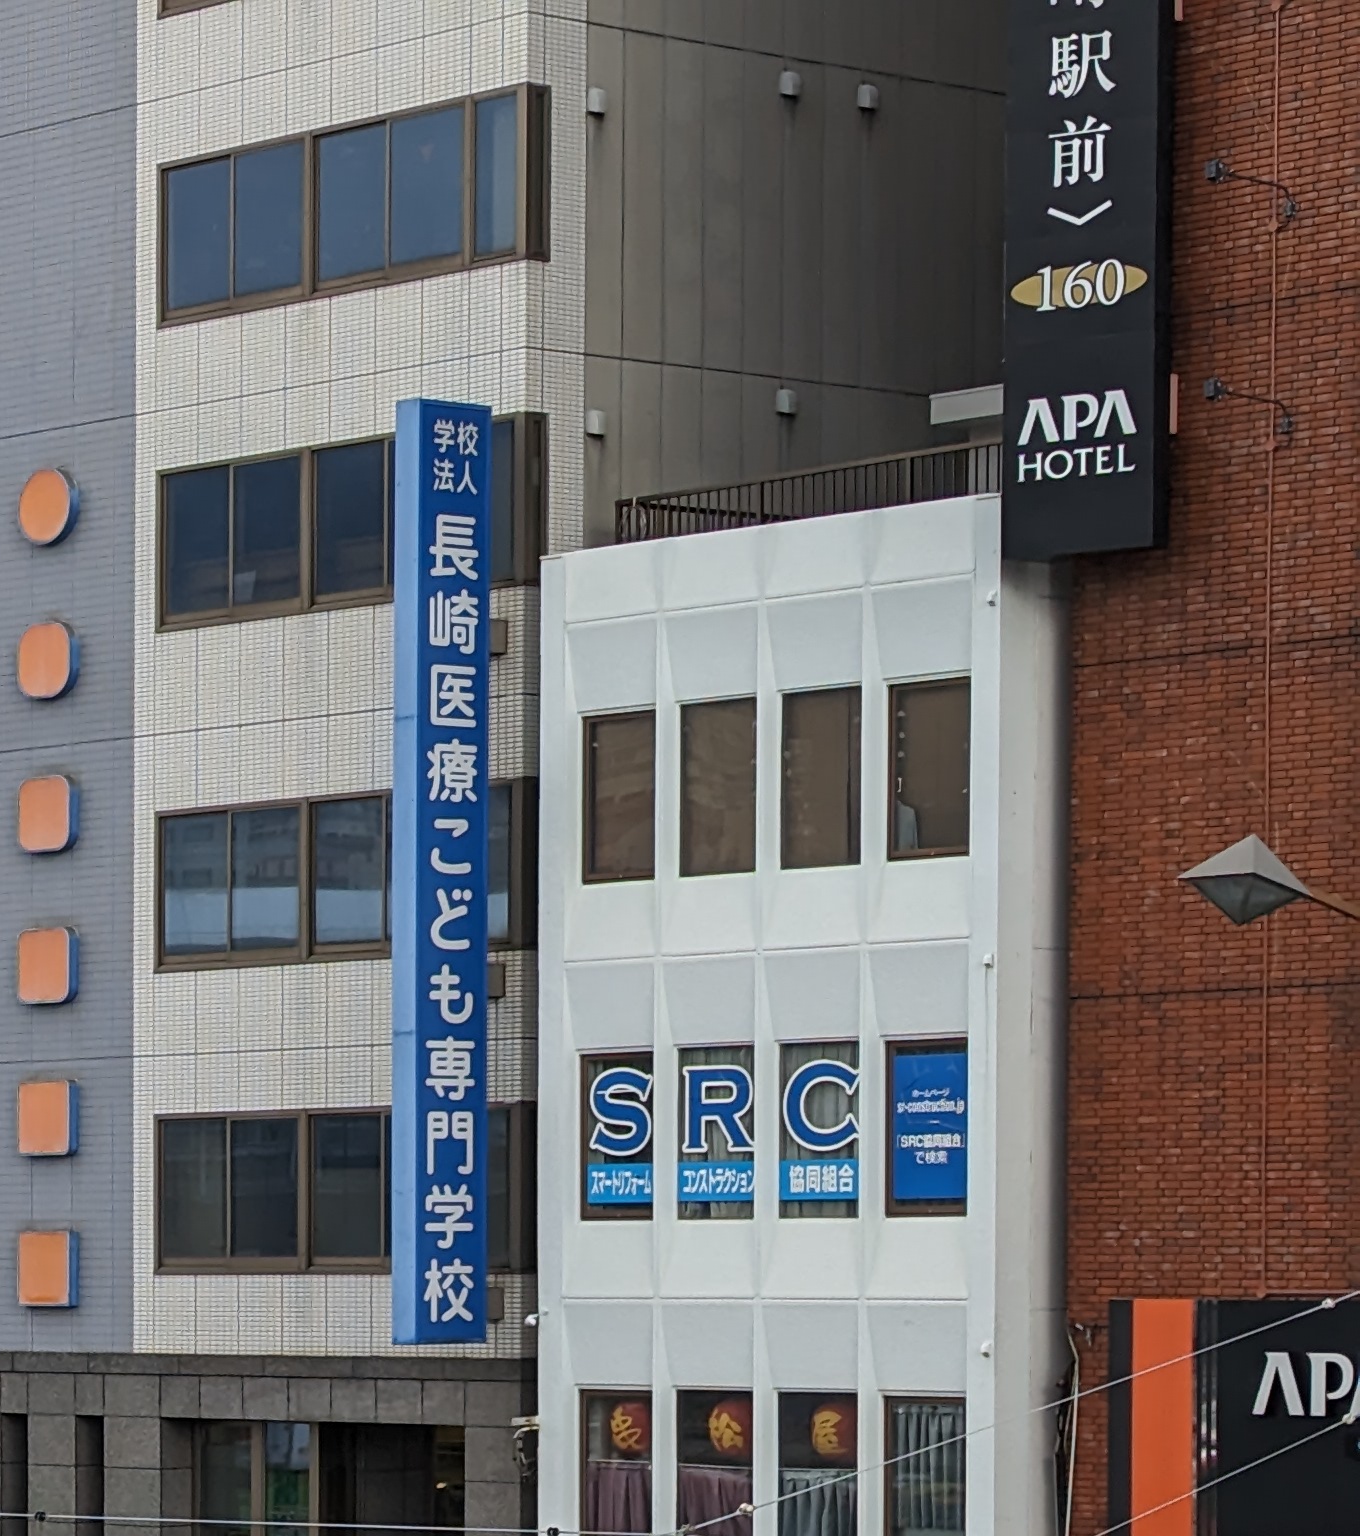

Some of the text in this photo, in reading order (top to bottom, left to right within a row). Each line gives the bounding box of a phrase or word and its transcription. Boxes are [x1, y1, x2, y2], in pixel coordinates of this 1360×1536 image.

[1036, 258, 1125, 312] 160
[1018, 389, 1137, 446] APA
[433, 418, 479, 457] 学校
[433, 458, 479, 496] 法人
[1017, 443, 1136, 483] HOTEL
[423, 513, 480, 1324] 長崎医療こども専門学校
[590, 1060, 859, 1158] SRC
[590, 1170, 652, 1196] スマートリフォーム
[682, 1168, 754, 1195] コンストラクション
[789, 1164, 855, 1195] 協同組合
